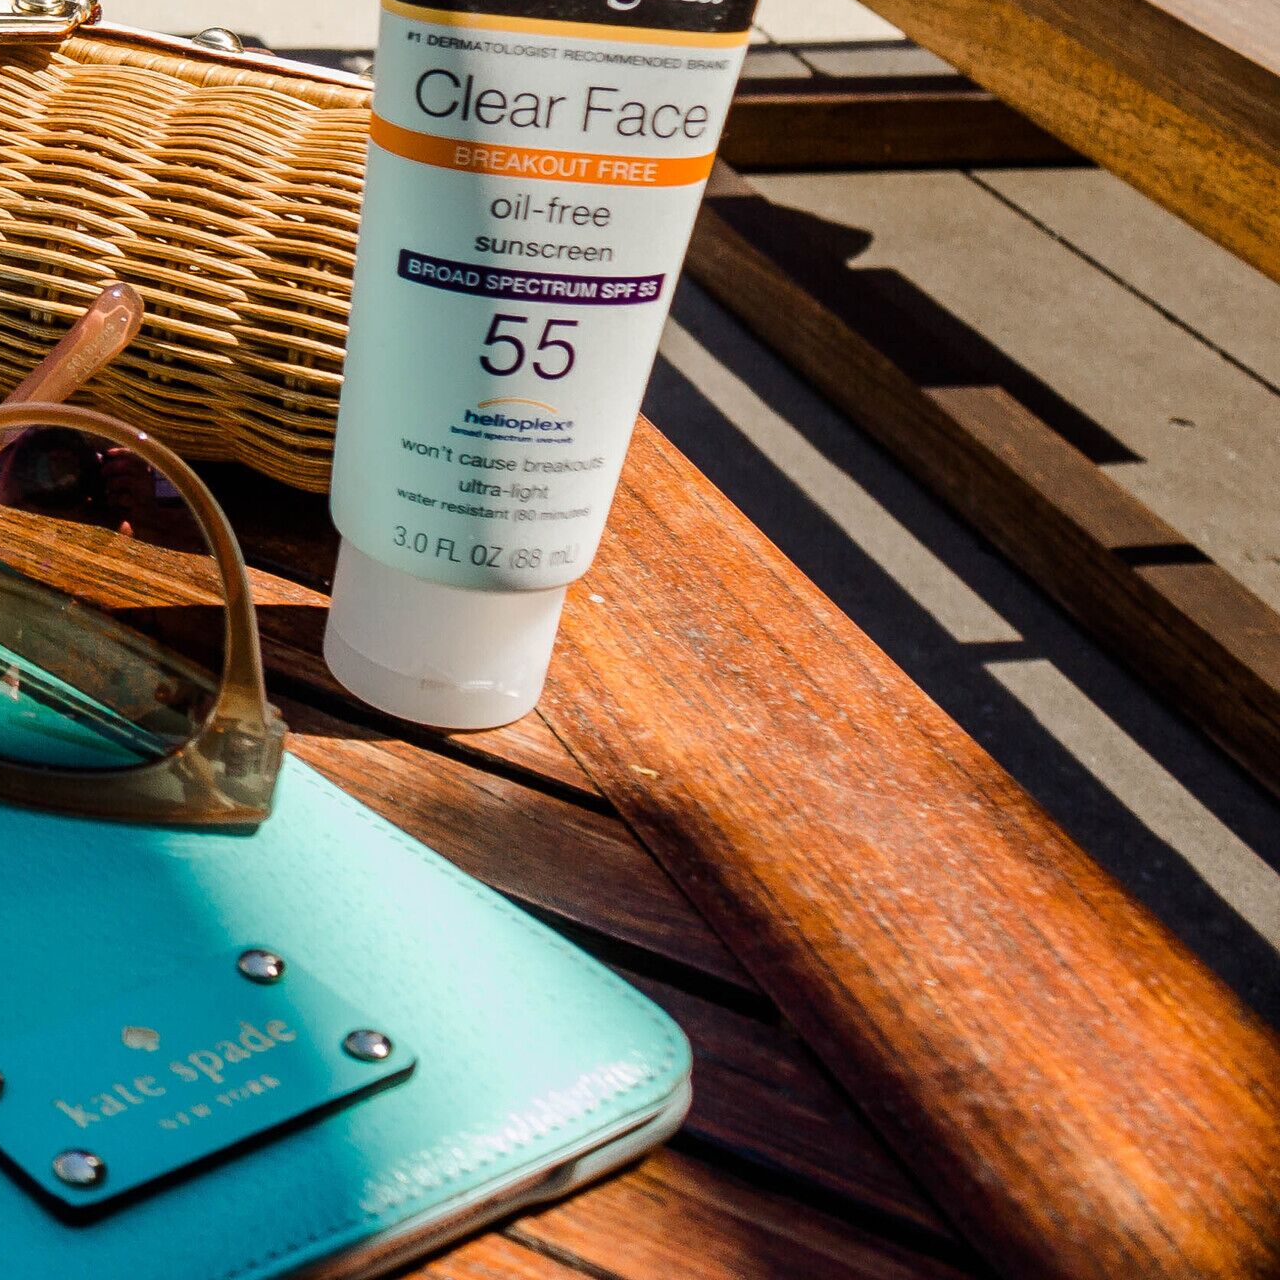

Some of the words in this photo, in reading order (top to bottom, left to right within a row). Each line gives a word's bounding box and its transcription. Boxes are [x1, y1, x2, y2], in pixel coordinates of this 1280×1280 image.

[406, 31, 422, 44] #1
[426, 34, 558, 59] DERMATOLOGIST
[563, 49, 682, 70] RECOMMENDED
[415, 68, 567, 129] Clear
[582, 85, 709, 139] Face
[453, 145, 591, 178] BREAKOUT
[596, 159, 658, 184] FREE
[490, 192, 612, 228] oil-free
[474, 235, 614, 263] sunscreen
[407, 258, 481, 287] BROAD
[485, 274, 597, 299] SPECTRUM
[600, 281, 638, 300] SPF
[479, 312, 580, 381] 55
[400, 437, 454, 463] won't
[458, 452, 517, 471] cause
[396, 487, 438, 508] water
[440, 500, 509, 521] resistant
[458, 478, 550, 503] ultra-light
[393, 525, 429, 554] 3.0
[435, 537, 462, 563] FL
[470, 543, 504, 569] OZ
[168, 1019, 298, 1085] spade
